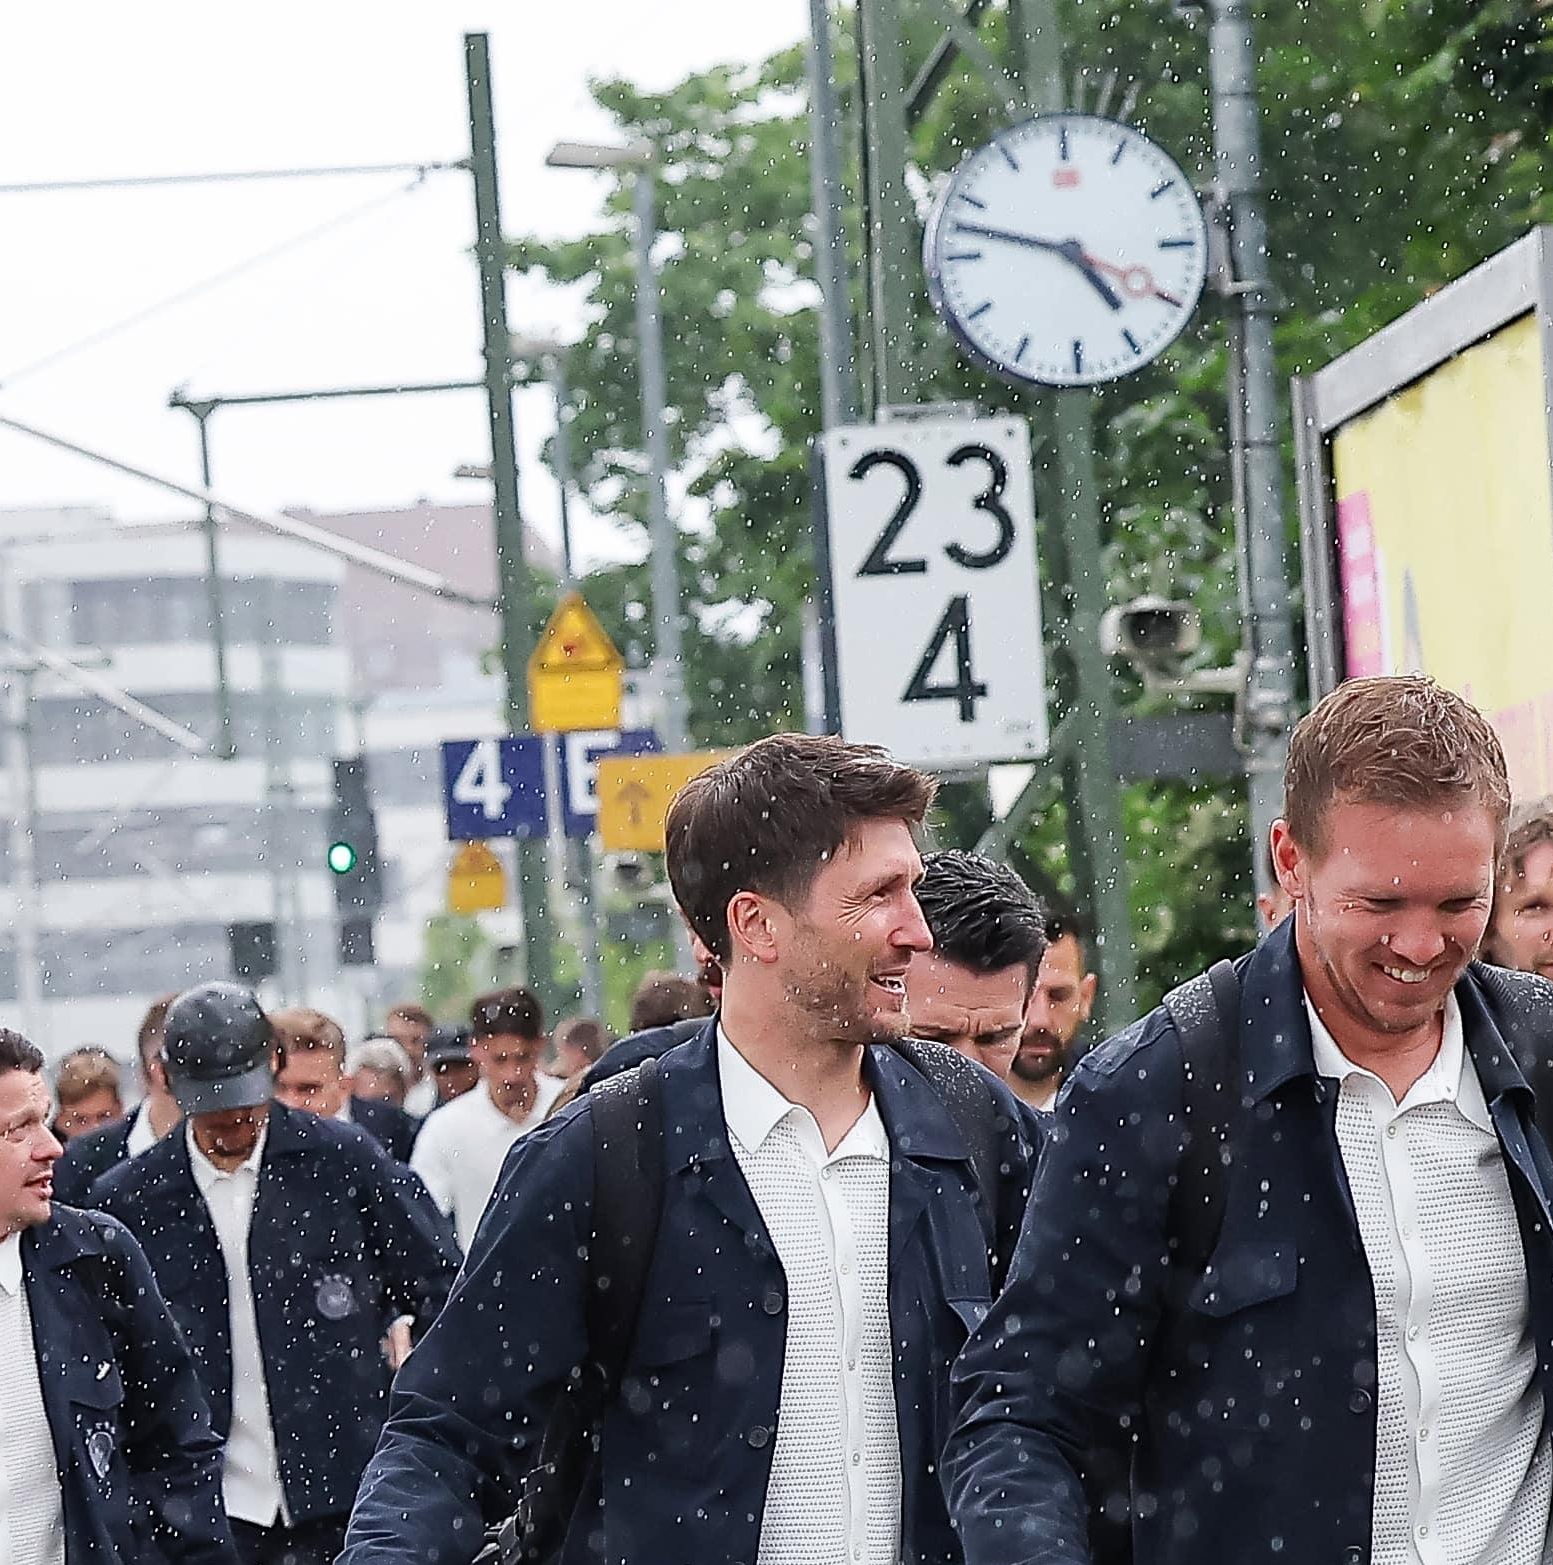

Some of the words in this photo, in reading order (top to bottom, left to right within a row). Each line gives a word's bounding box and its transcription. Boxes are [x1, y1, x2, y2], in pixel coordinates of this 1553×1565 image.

[848, 444, 1017, 578] 23
[900, 596, 988, 723] 4
[451, 739, 513, 820] 4
